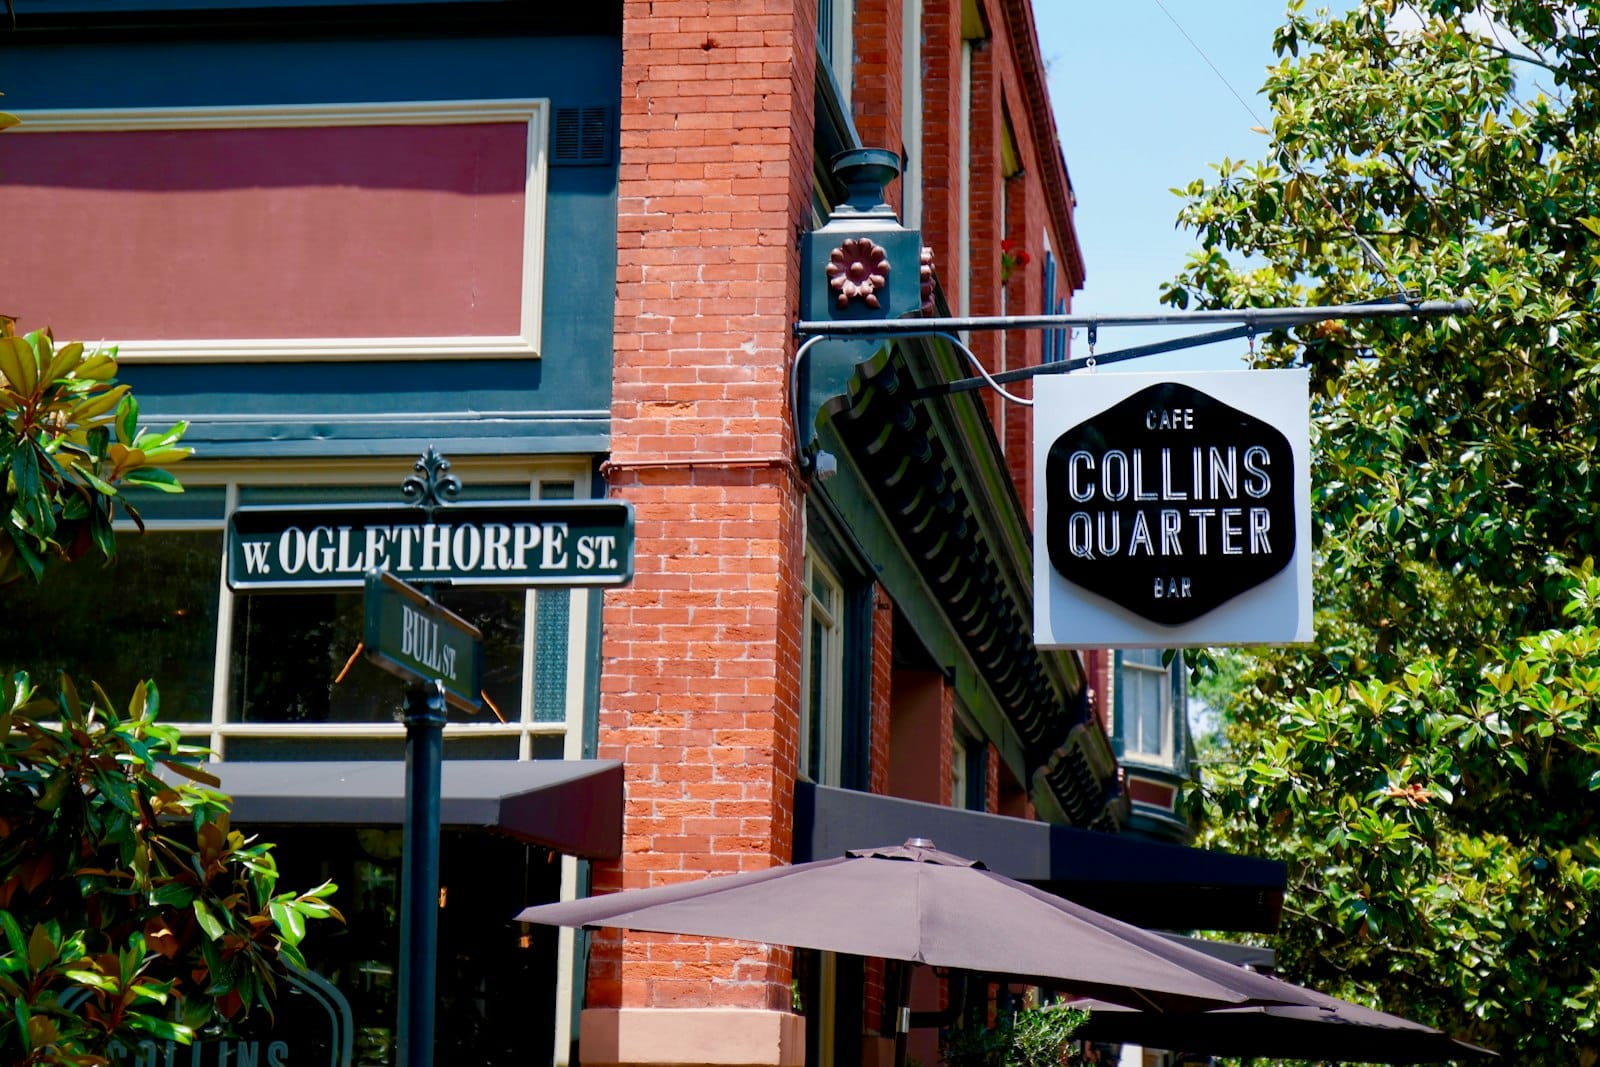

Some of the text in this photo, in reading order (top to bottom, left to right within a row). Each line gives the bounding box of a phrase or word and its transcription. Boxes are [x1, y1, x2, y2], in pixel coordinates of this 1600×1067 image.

[1146, 408, 1194, 430] CAFE
[1068, 446, 1272, 503] COLLINS
[241, 521, 618, 575] W. OGLETHORPE ST.
[1068, 507, 1273, 561] QUARTER
[1153, 576, 1192, 599] BAR
[401, 604, 442, 673] BULL
